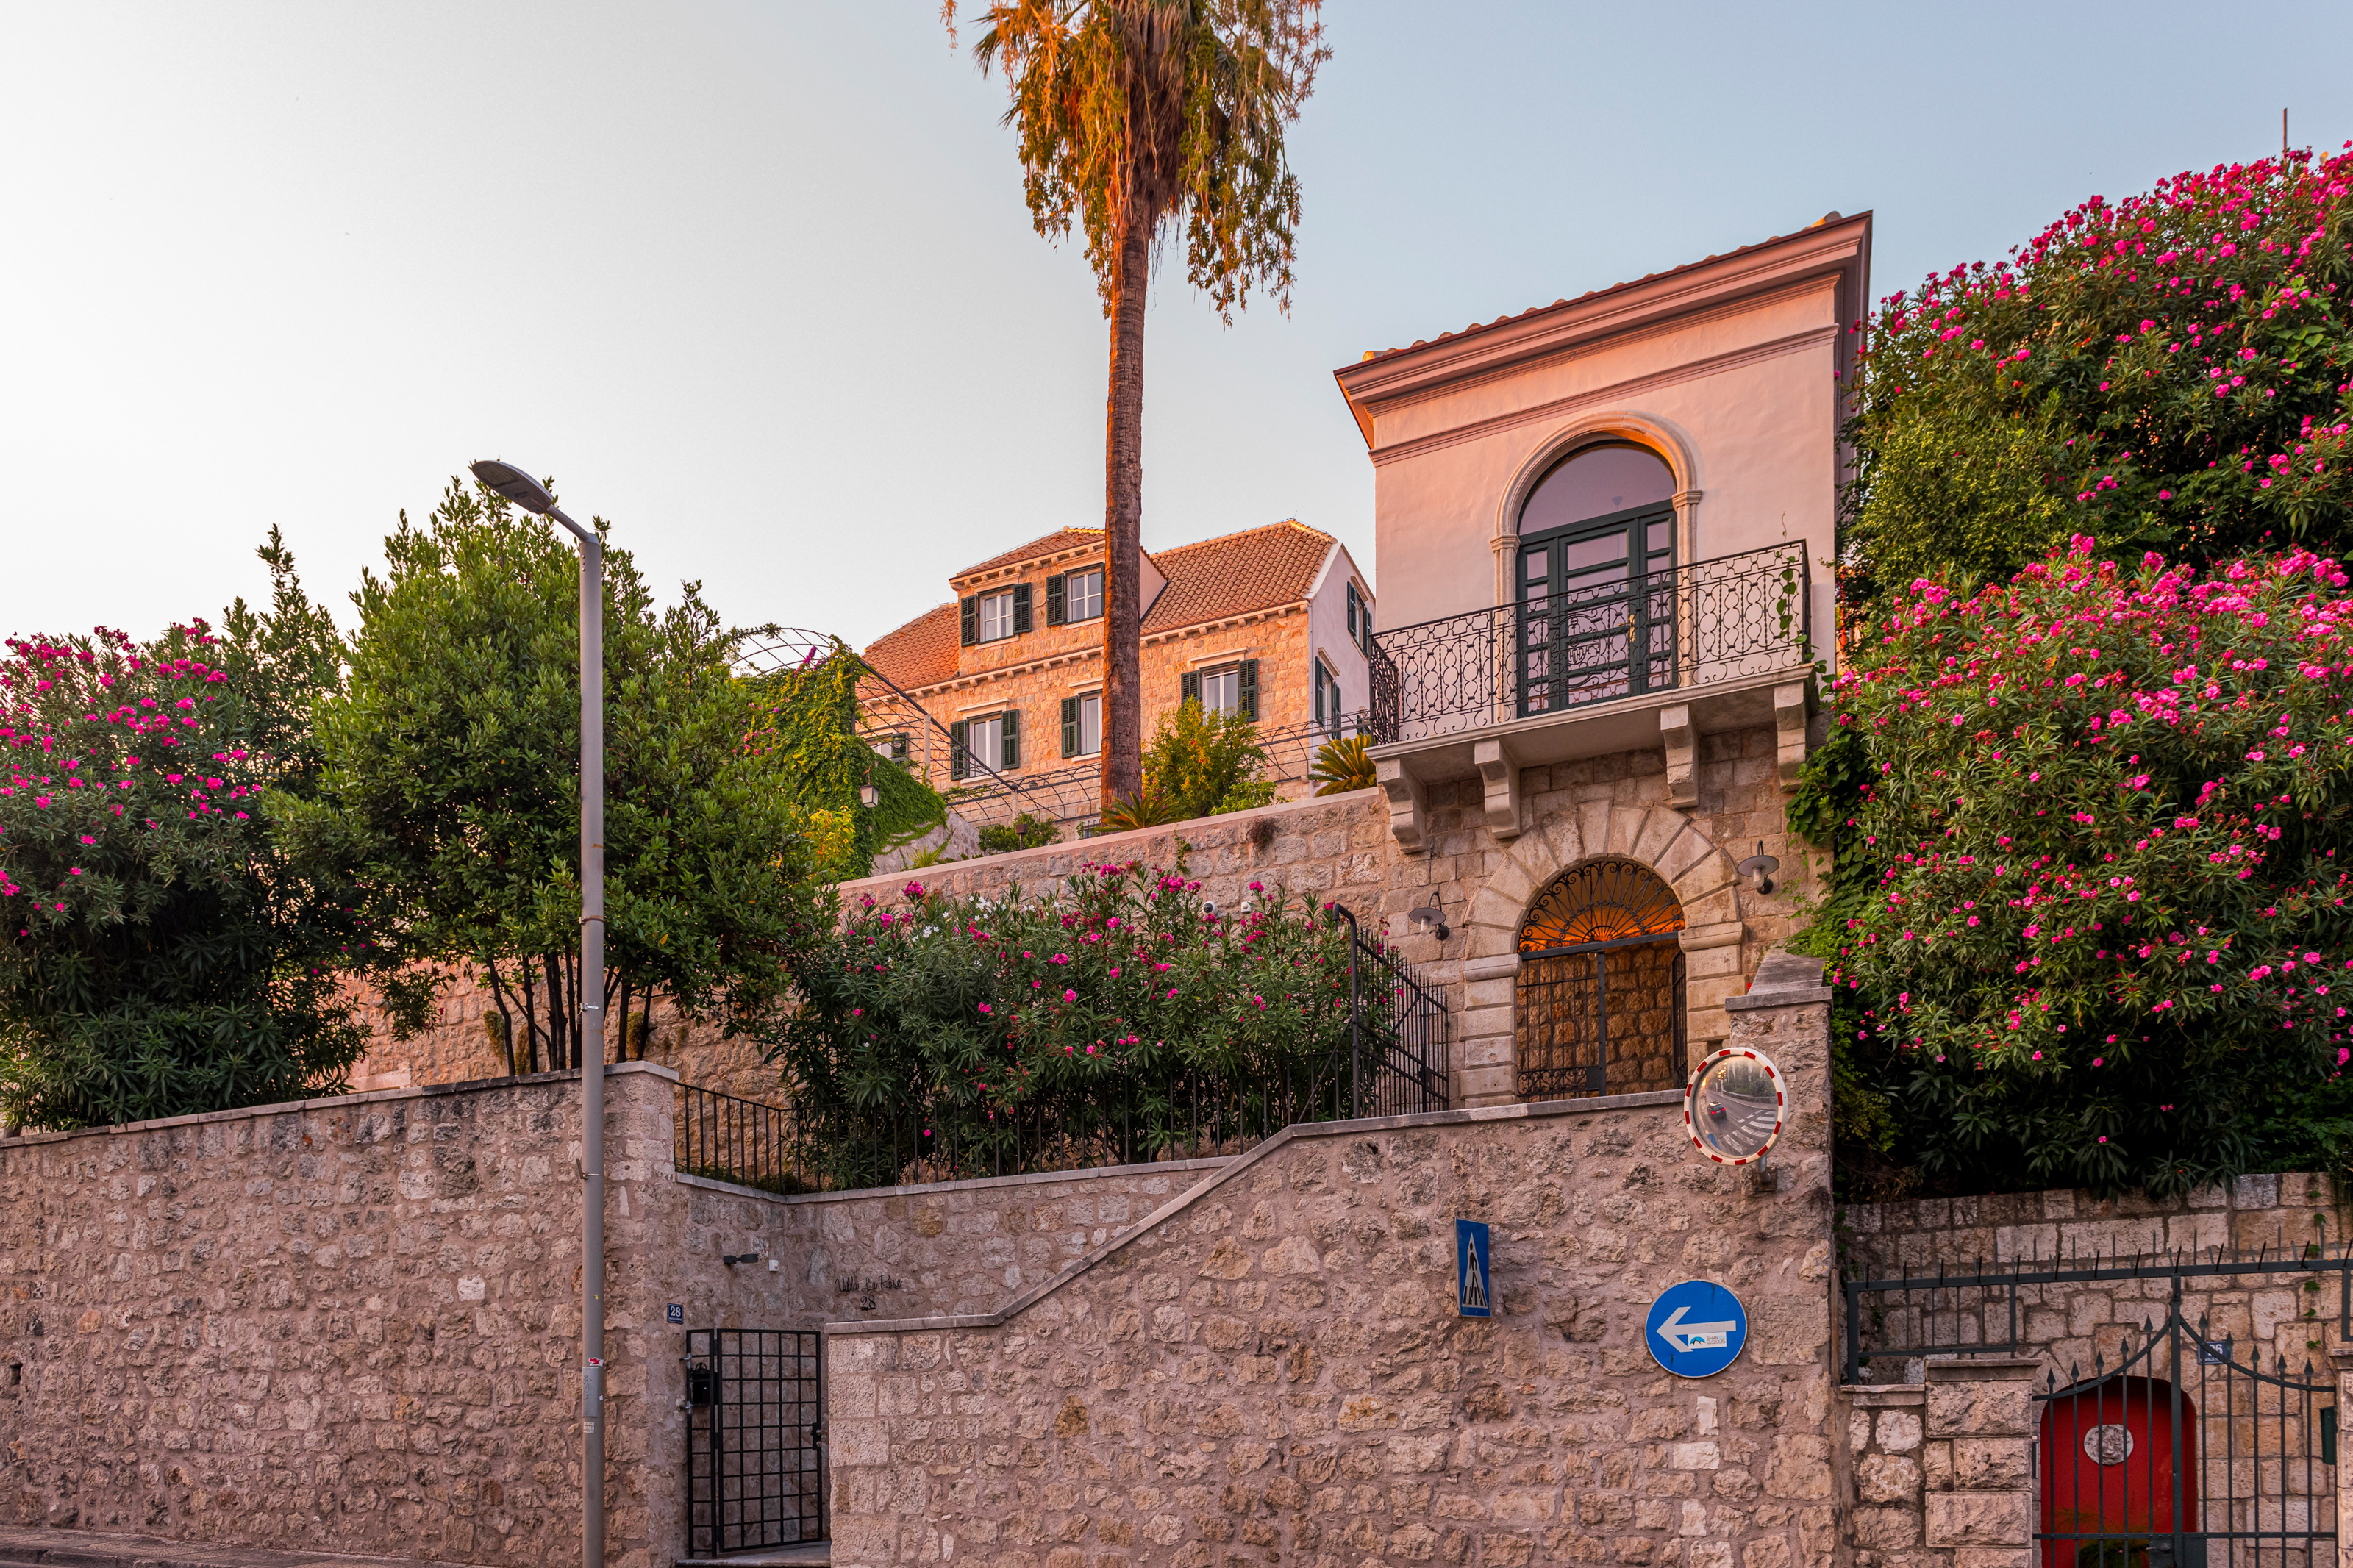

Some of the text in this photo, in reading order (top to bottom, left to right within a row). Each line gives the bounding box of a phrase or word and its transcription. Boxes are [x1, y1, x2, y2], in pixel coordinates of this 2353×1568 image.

[835, 1274, 902, 1292] Villa La Rose
[860, 1295, 876, 1310] 28
[670, 1306, 681, 1317] 28
